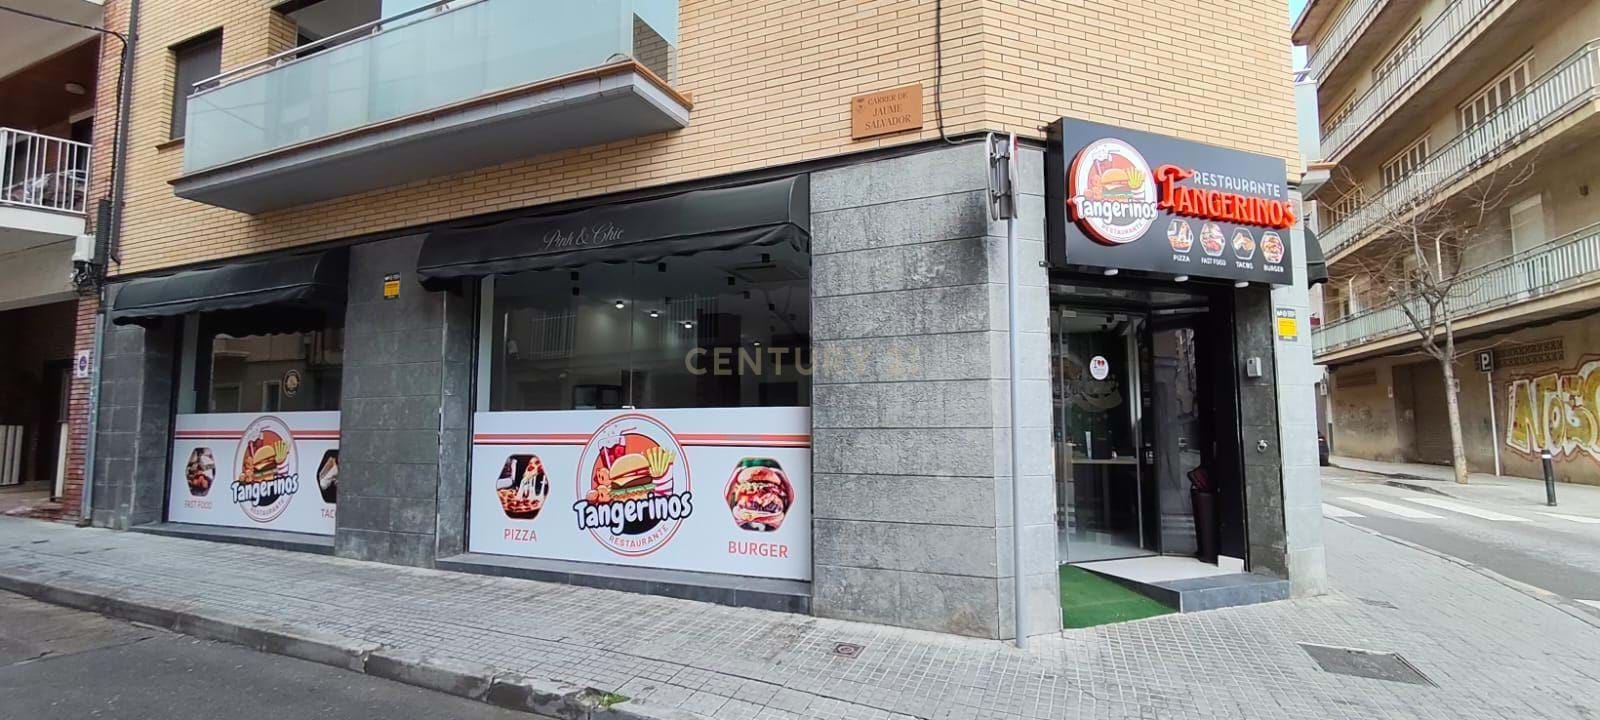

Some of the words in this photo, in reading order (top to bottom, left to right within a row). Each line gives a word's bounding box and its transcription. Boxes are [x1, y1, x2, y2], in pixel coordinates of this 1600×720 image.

[868, 95, 896, 105] CARRER
[873, 103, 903, 117] JAUME
[865, 114, 911, 130] SALVADOR
[1193, 171, 1281, 197] RESTAURANTE
[1074, 194, 1158, 225] Tangerinos
[543, 229, 574, 250] Pink
[576, 226, 590, 246] &
[592, 222, 625, 245] Chic
[1173, 254, 1190, 263] PIZZA
[1235, 261, 1254, 270] TACOS
[1264, 264, 1284, 273] BURGER
[1481, 353, 1491, 371] P
[230, 473, 299, 506] Tangerinos
[184, 499, 197, 509] FAST
[574, 493, 692, 534] Tangerinos
[503, 528, 538, 542] PIZZA
[608, 524, 669, 549] RESTAURANTE
[727, 541, 788, 559] BURGER
